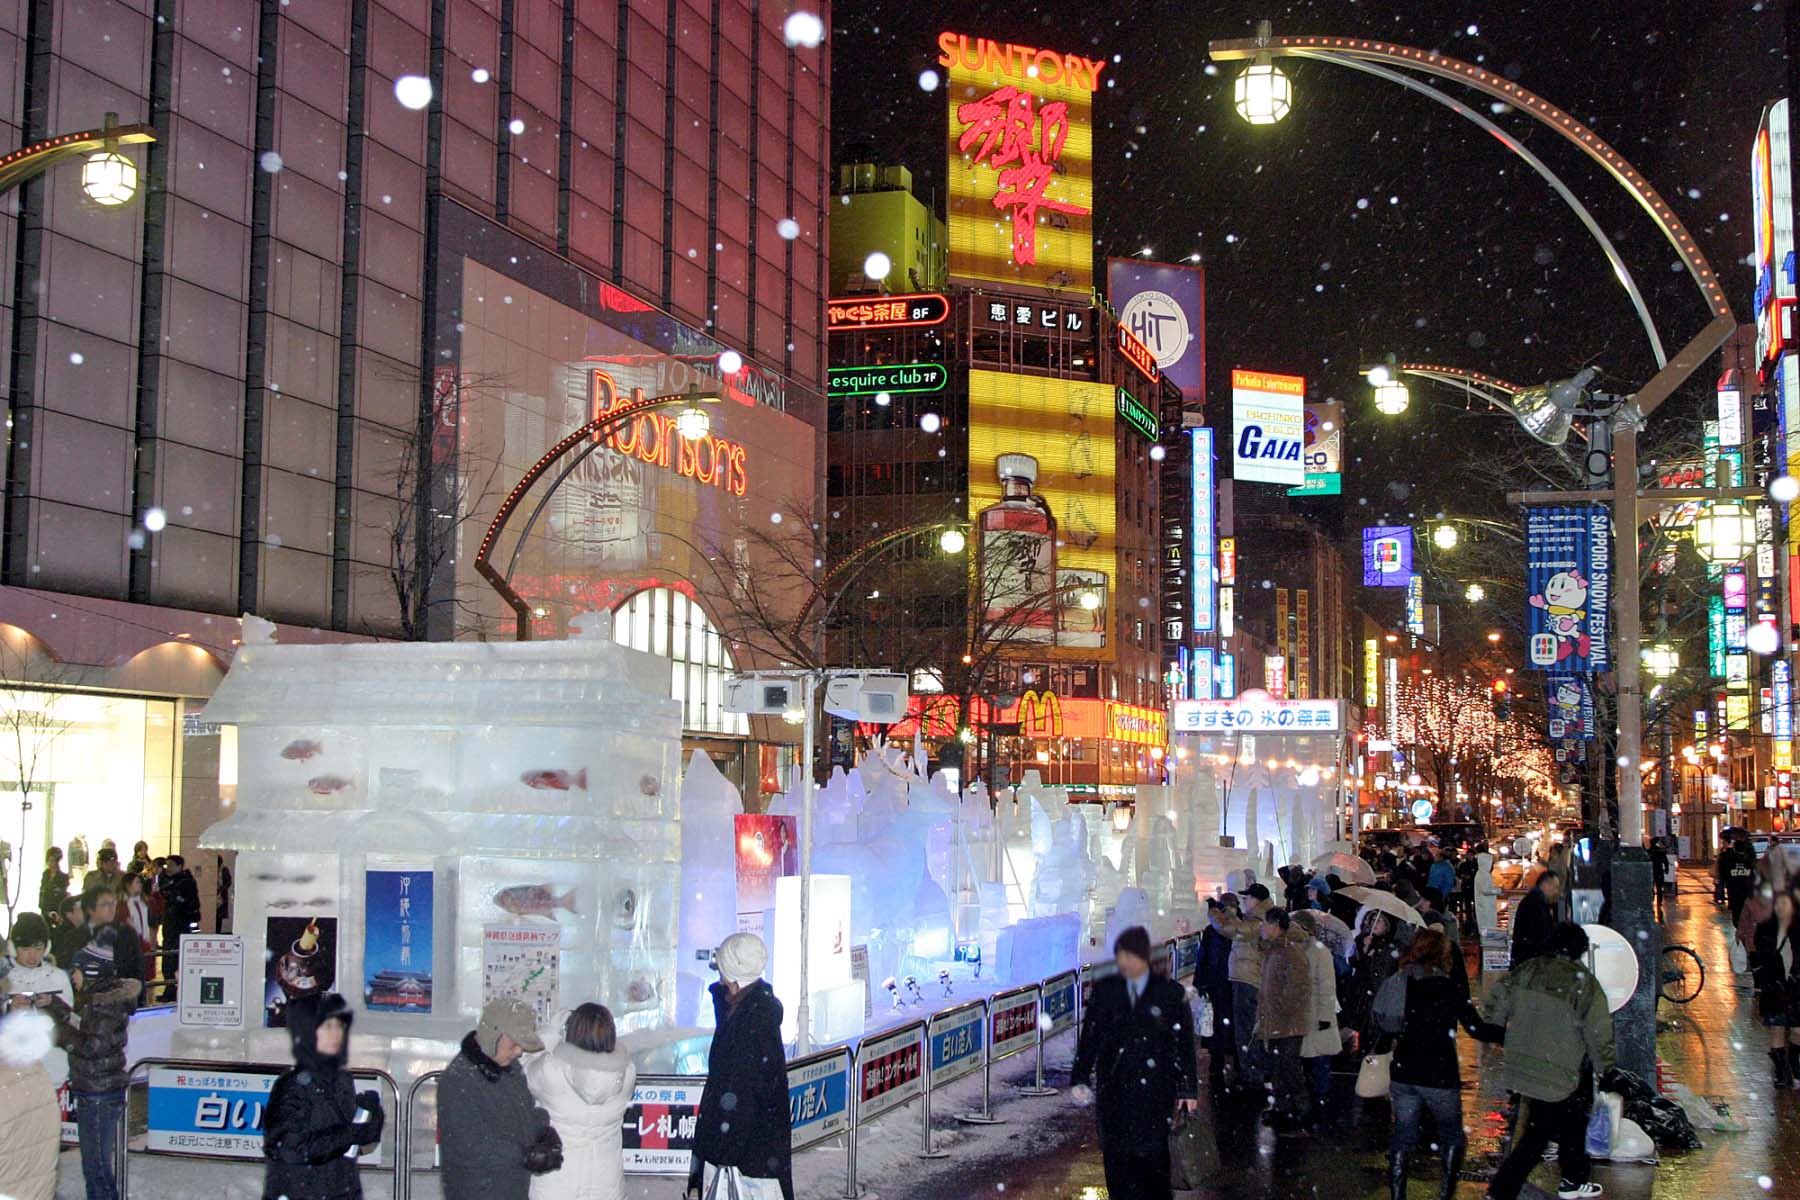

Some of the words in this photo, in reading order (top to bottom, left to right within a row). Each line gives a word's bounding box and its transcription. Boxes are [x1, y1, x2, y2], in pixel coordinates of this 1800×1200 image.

[939, 31, 1105, 92] SUNTORY
[912, 307, 930, 320] 8F
[990, 303, 1083, 331] 恵愛ビル
[832, 373, 887, 392] esquire
[890, 368, 922, 385] club
[923, 372, 938, 383] 7F
[1591, 515, 1608, 570] SAPPORO
[1591, 573, 1608, 612] SNOW
[1590, 614, 1608, 667] FESTIVAL
[1187, 708, 1254, 728] すすきの
[1260, 708, 1332, 728] 氷の祭典
[943, 1024, 973, 1062] 白い恋人
